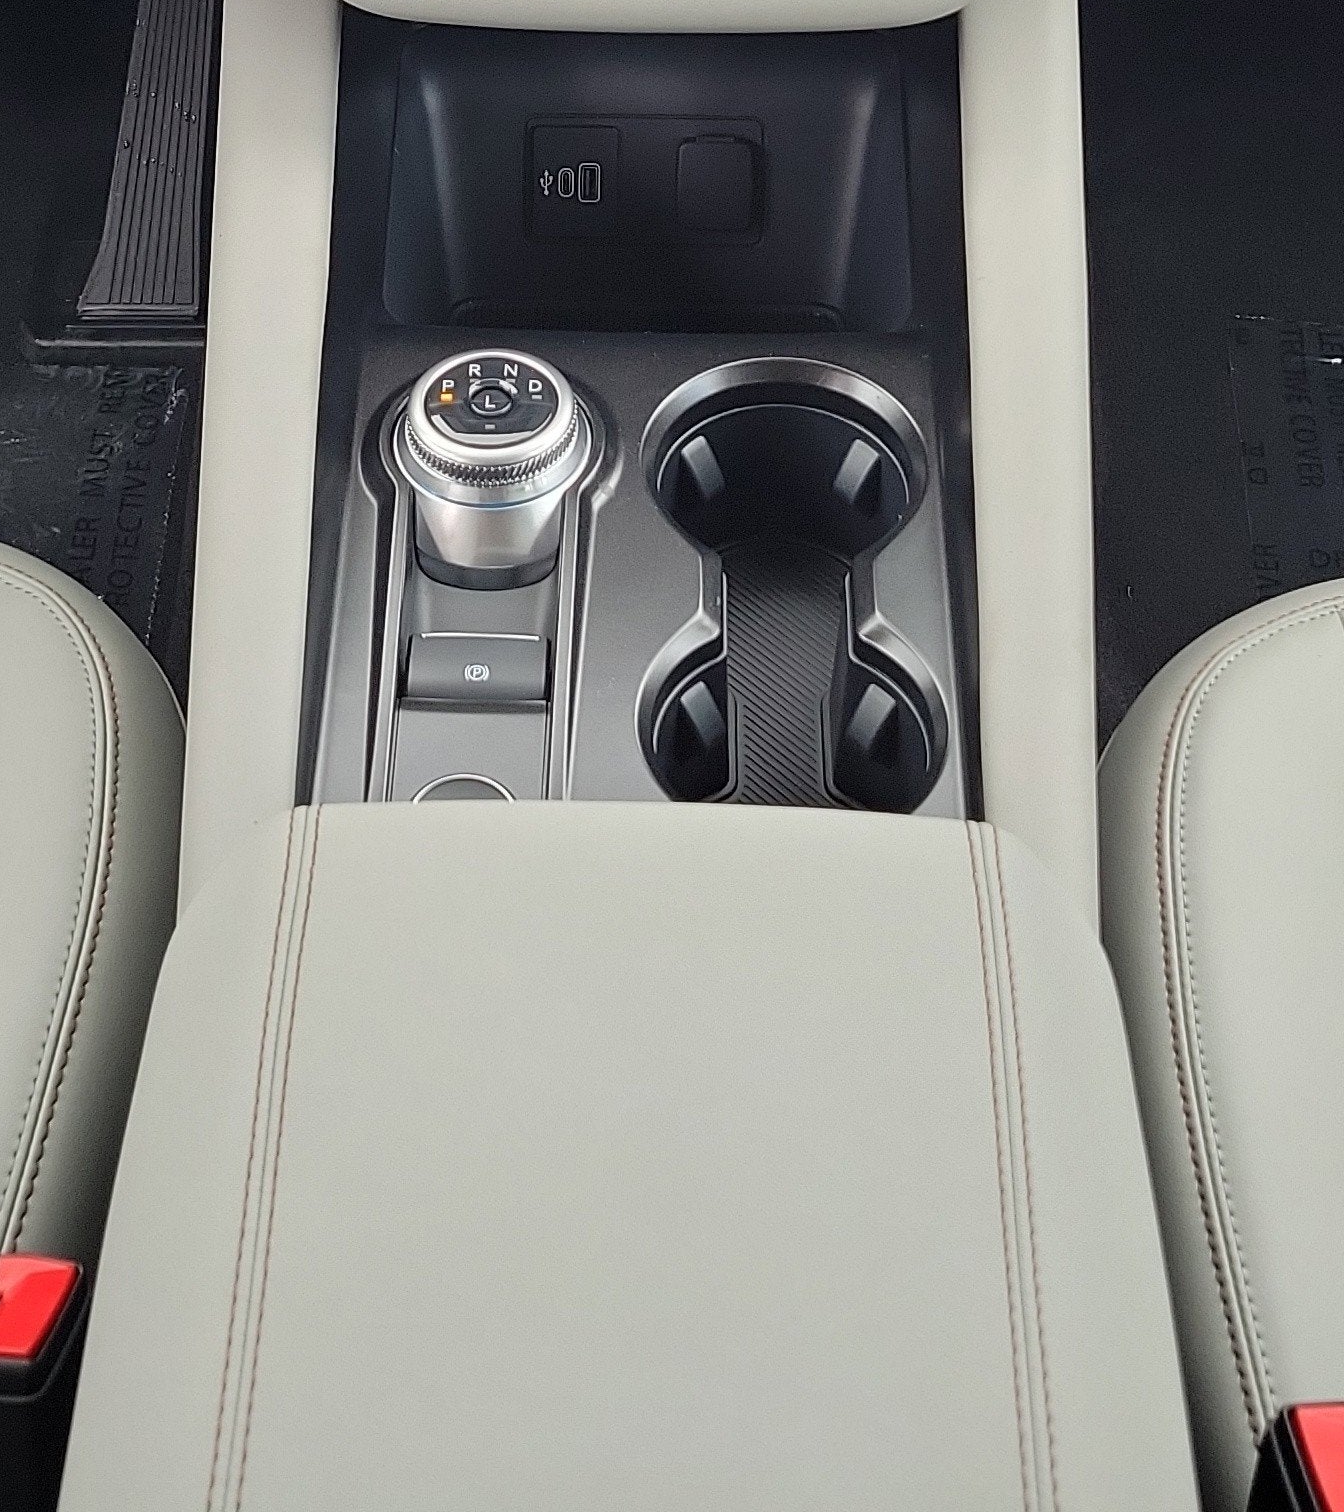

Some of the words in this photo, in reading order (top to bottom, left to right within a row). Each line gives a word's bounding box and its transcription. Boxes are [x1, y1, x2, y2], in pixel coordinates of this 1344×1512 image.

[468, 363, 482, 377] R
[503, 363, 519, 377] N
[441, 380, 454, 393] P
[528, 379, 543, 392] D
